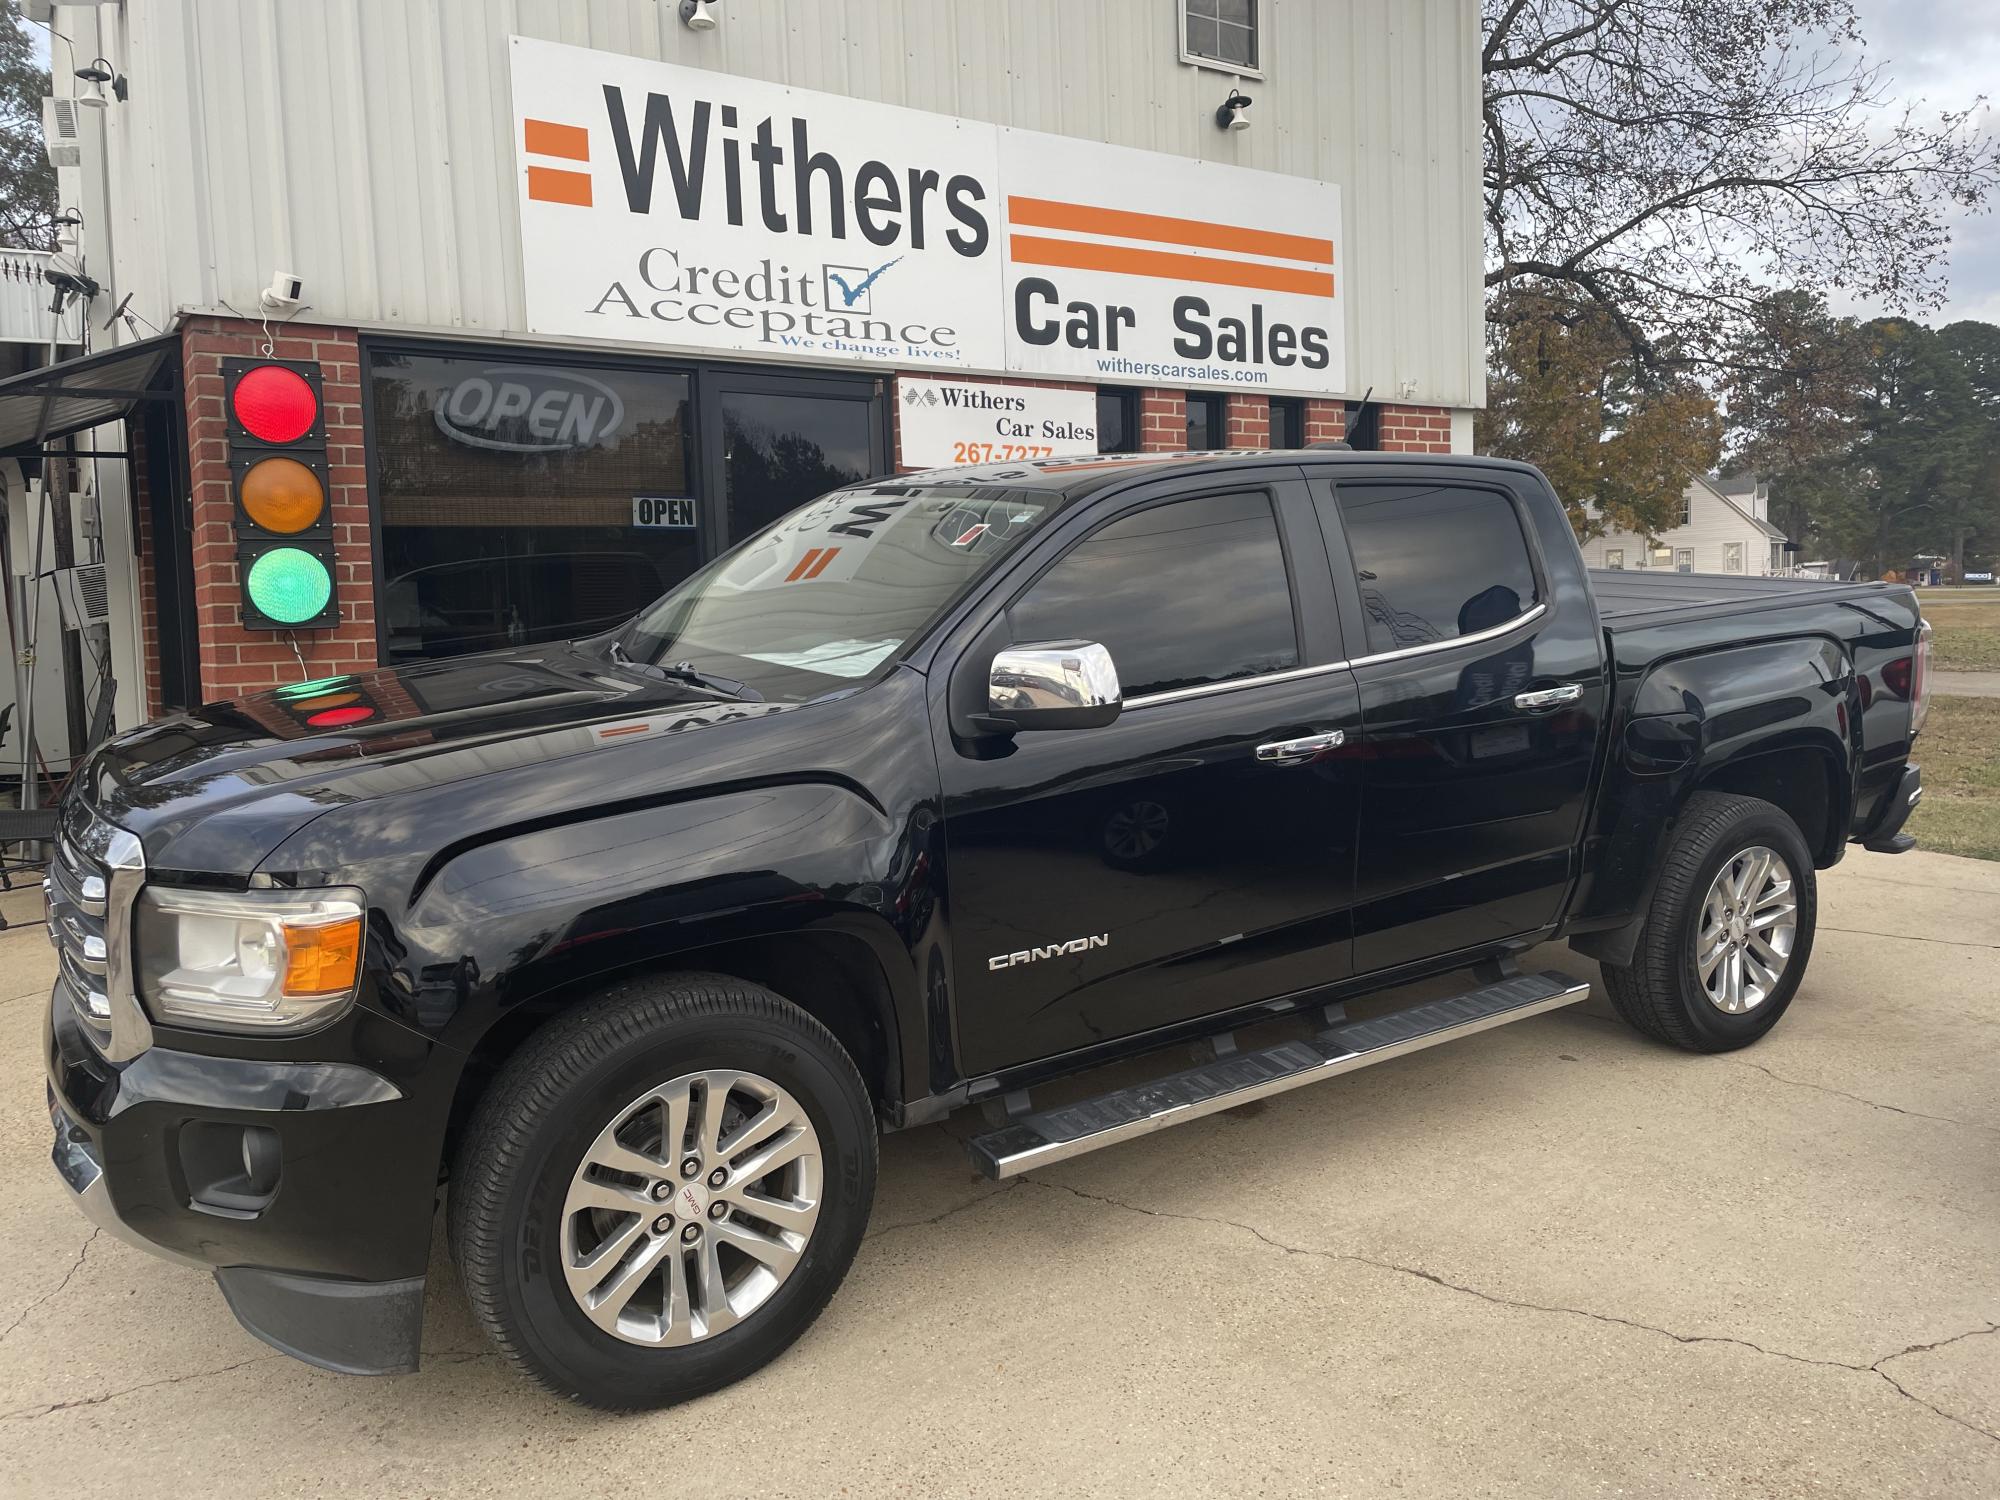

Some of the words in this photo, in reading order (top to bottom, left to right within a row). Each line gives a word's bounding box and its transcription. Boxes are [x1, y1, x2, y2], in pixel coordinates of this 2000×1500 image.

[602, 84, 989, 258] Withers
[638, 247, 818, 307] Credit
[585, 281, 957, 347] Acceptance
[1014, 276, 1136, 352] Car
[1172, 295, 1330, 370] Sales
[780, 335, 814, 348] We
[822, 339, 900, 358] change
[907, 345, 961, 360] lives!
[1096, 358, 1268, 384] witherscarsales.com
[447, 378, 604, 444] OPEN
[940, 387, 1025, 412] Withers
[996, 417, 1034, 438] Car
[1042, 420, 1095, 441] Sales
[639, 499, 693, 525] OPEN
[988, 933, 1109, 971] CANYON
[683, 1188, 701, 1214] GMC
